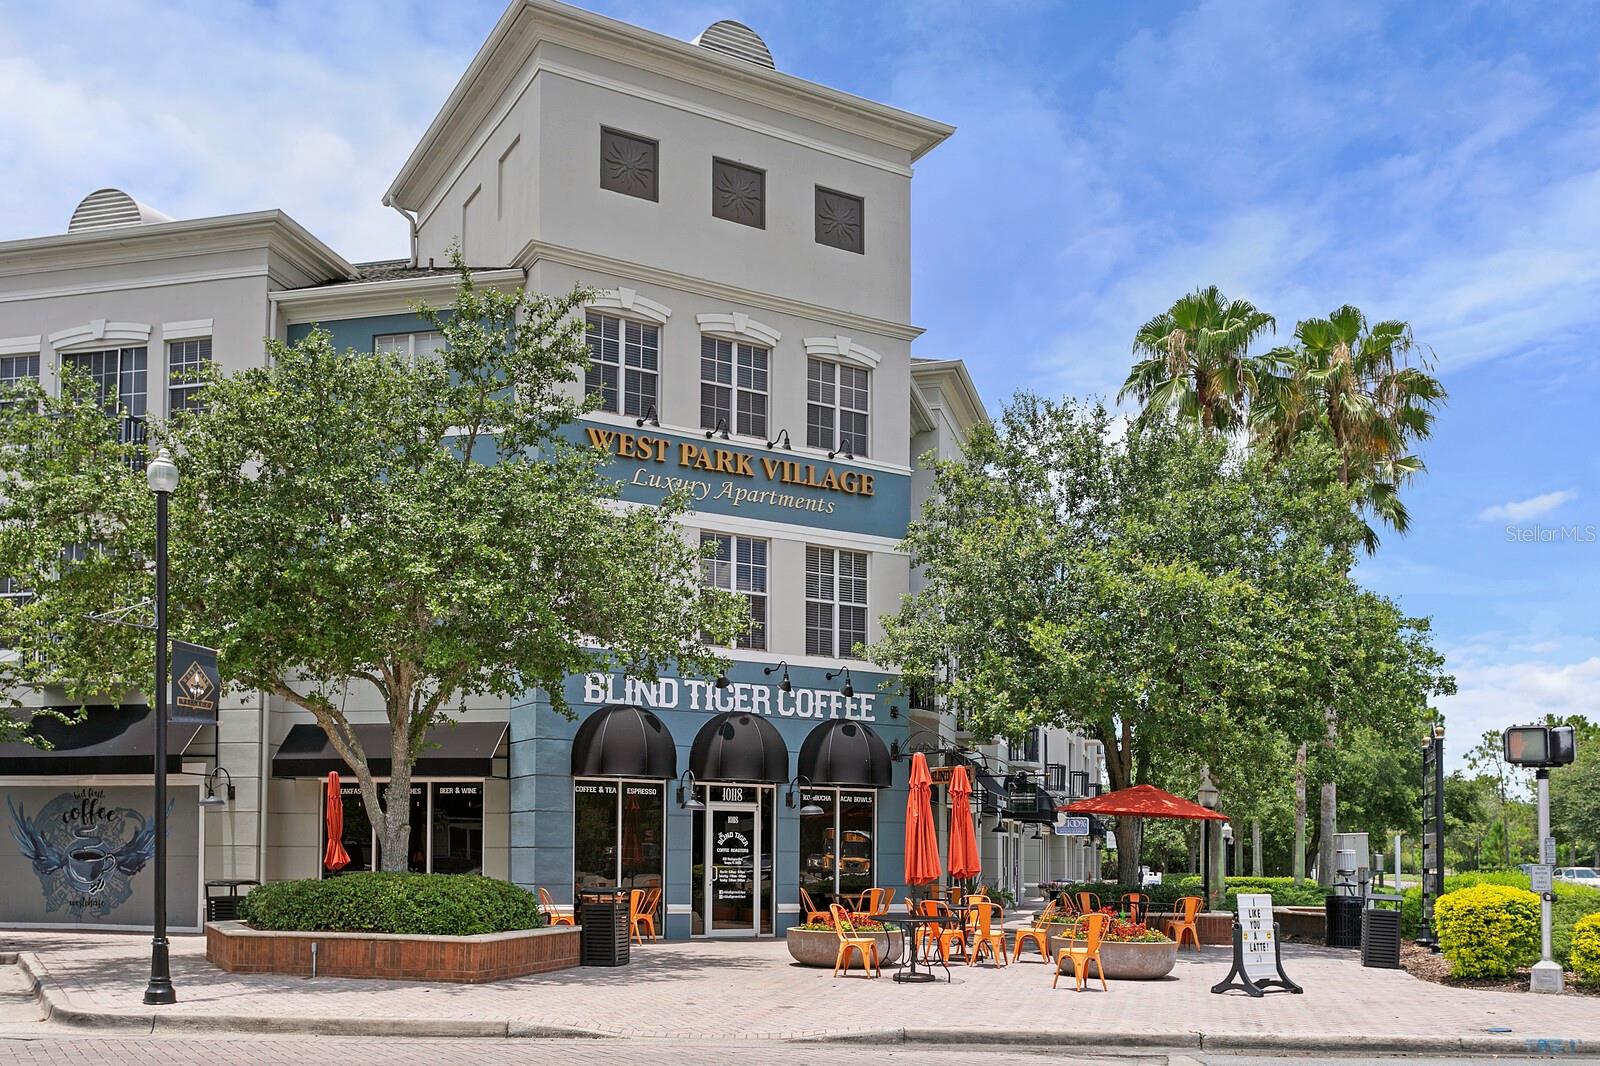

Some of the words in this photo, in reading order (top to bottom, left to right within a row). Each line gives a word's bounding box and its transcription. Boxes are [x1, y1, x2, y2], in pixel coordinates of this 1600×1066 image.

[585, 426, 671, 463] WEST
[679, 442, 755, 477] PARK
[760, 457, 875, 496] VILLAGE
[631, 468, 711, 500] Luxury
[713, 481, 836, 514] Apartments
[583, 672, 679, 708] BLIND
[683, 679, 771, 715] TIGER
[777, 685, 876, 721] COFFEE
[722, 787, 743, 802] 10118
[802, 793, 831, 802] KOBUCHA
[62, 798, 119, 825] coffee
[717, 831, 734, 846] BLIND
[734, 831, 749, 847] TIGER
[1248, 909, 1261, 918] LIKE
[1249, 920, 1261, 929] YOU
[1253, 932, 1258, 940] A
[1249, 942, 1270, 952] LATTE!
